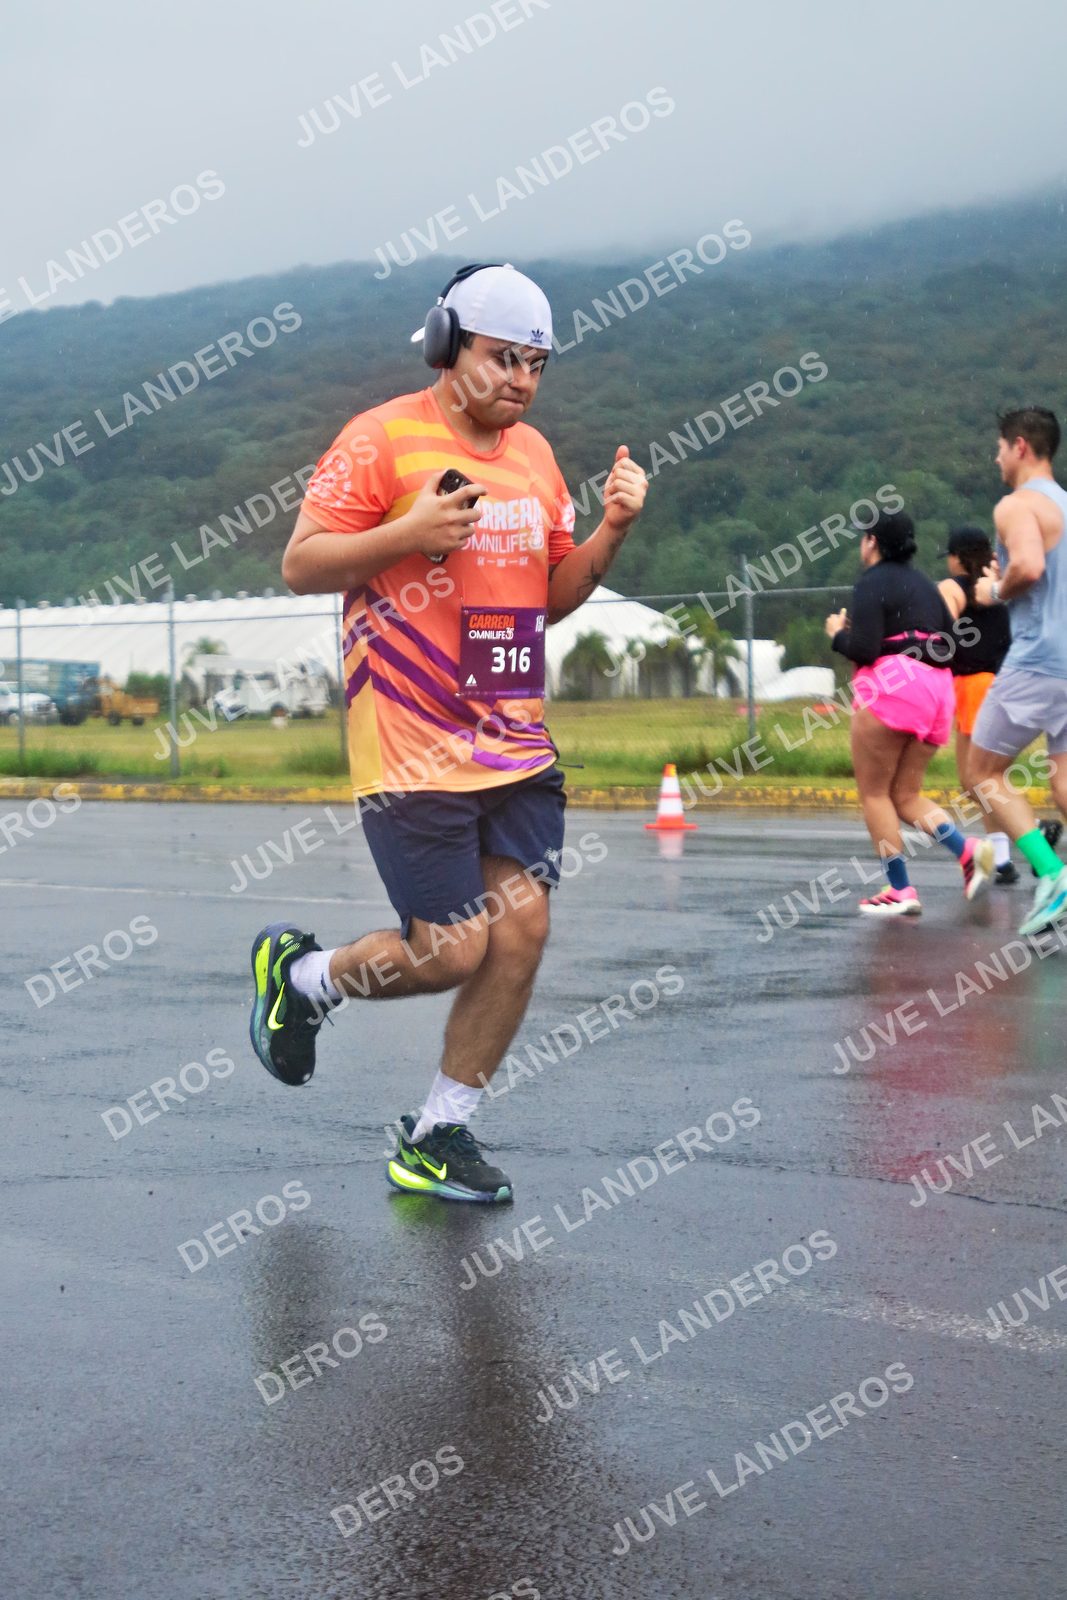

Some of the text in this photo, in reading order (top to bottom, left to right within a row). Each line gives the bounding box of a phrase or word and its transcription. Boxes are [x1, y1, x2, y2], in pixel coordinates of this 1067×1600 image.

[469, 614, 515, 629] CARRERA
[468, 629, 506, 640] OMNILIFE
[491, 646, 531, 673] 316
